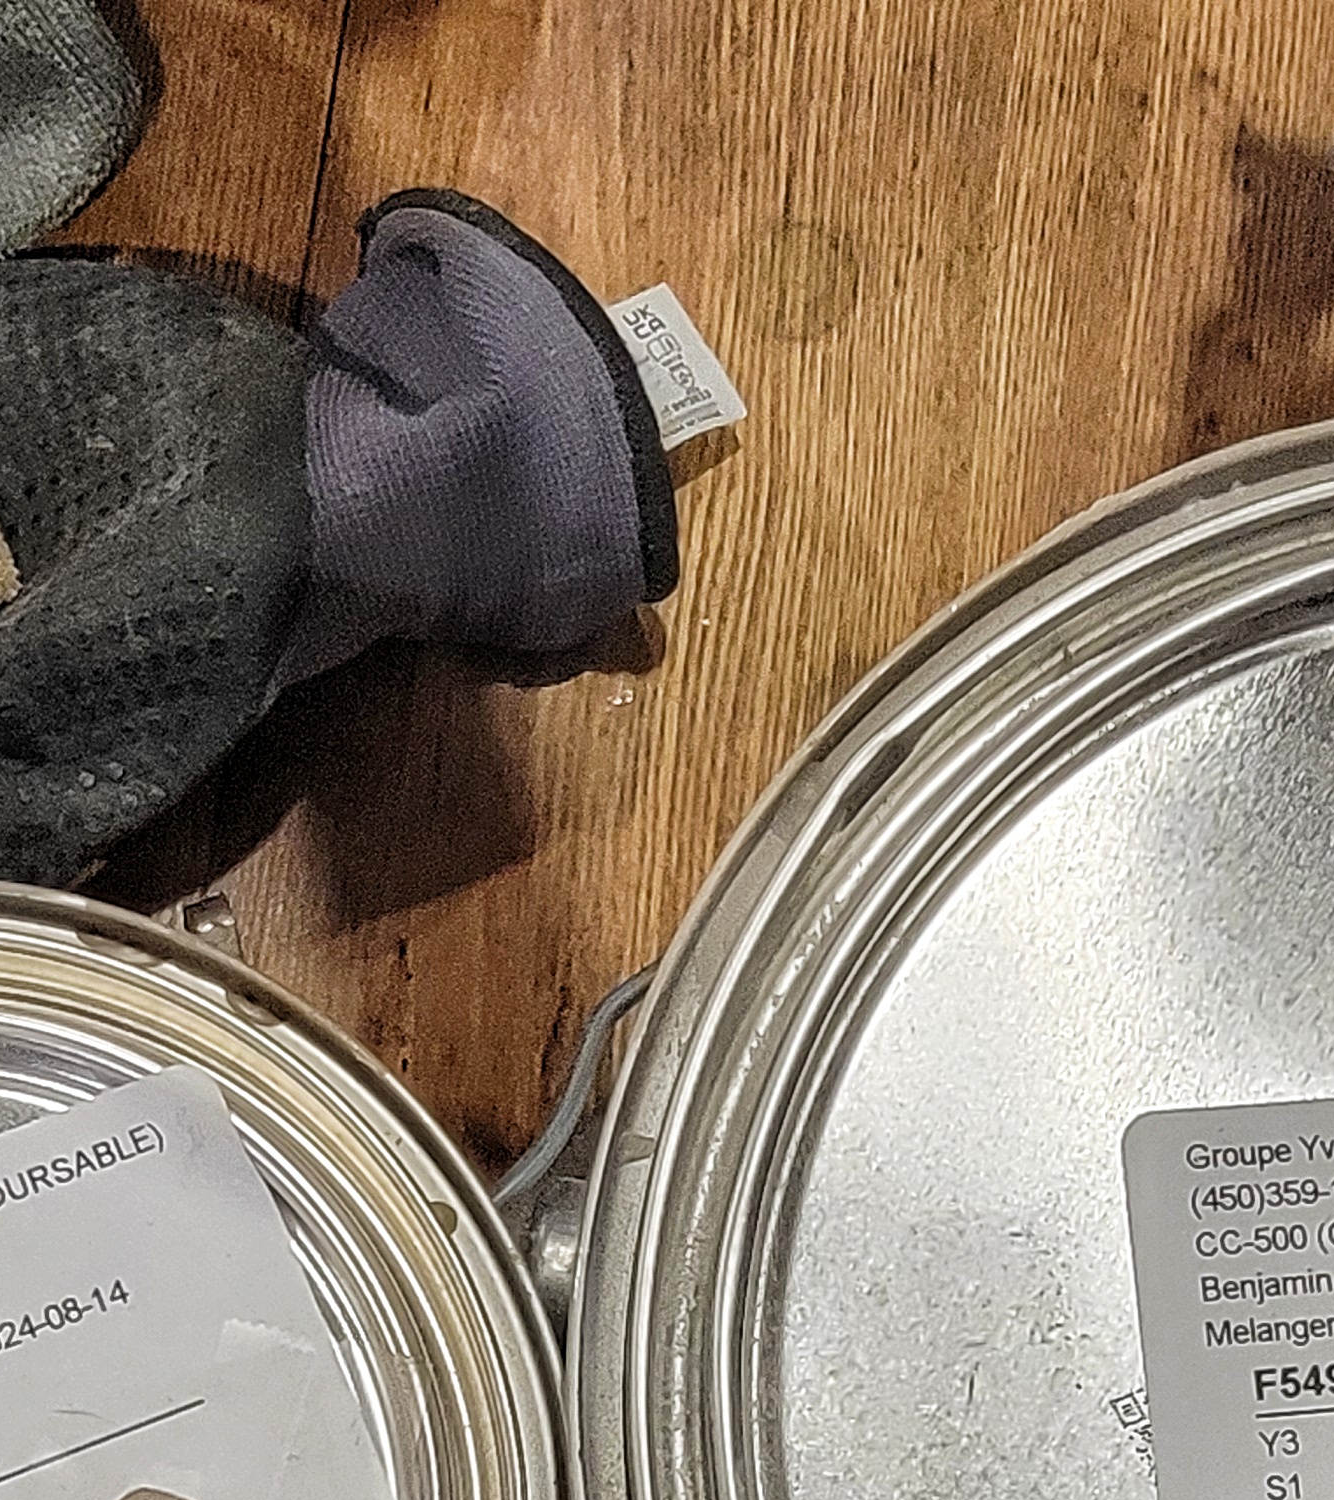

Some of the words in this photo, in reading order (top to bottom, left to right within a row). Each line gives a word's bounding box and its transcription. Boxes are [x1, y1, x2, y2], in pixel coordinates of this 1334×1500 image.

[621, 304, 654, 326] UK
[633, 316, 666, 340] CA
[1186, 1143, 1292, 1172] Groupe
[1195, 1224, 1308, 1257] CC-500
[1200, 1267, 1333, 1306] Benjamin
[1258, 1429, 1300, 1458] Y3
[1266, 1473, 1301, 1500] S1
